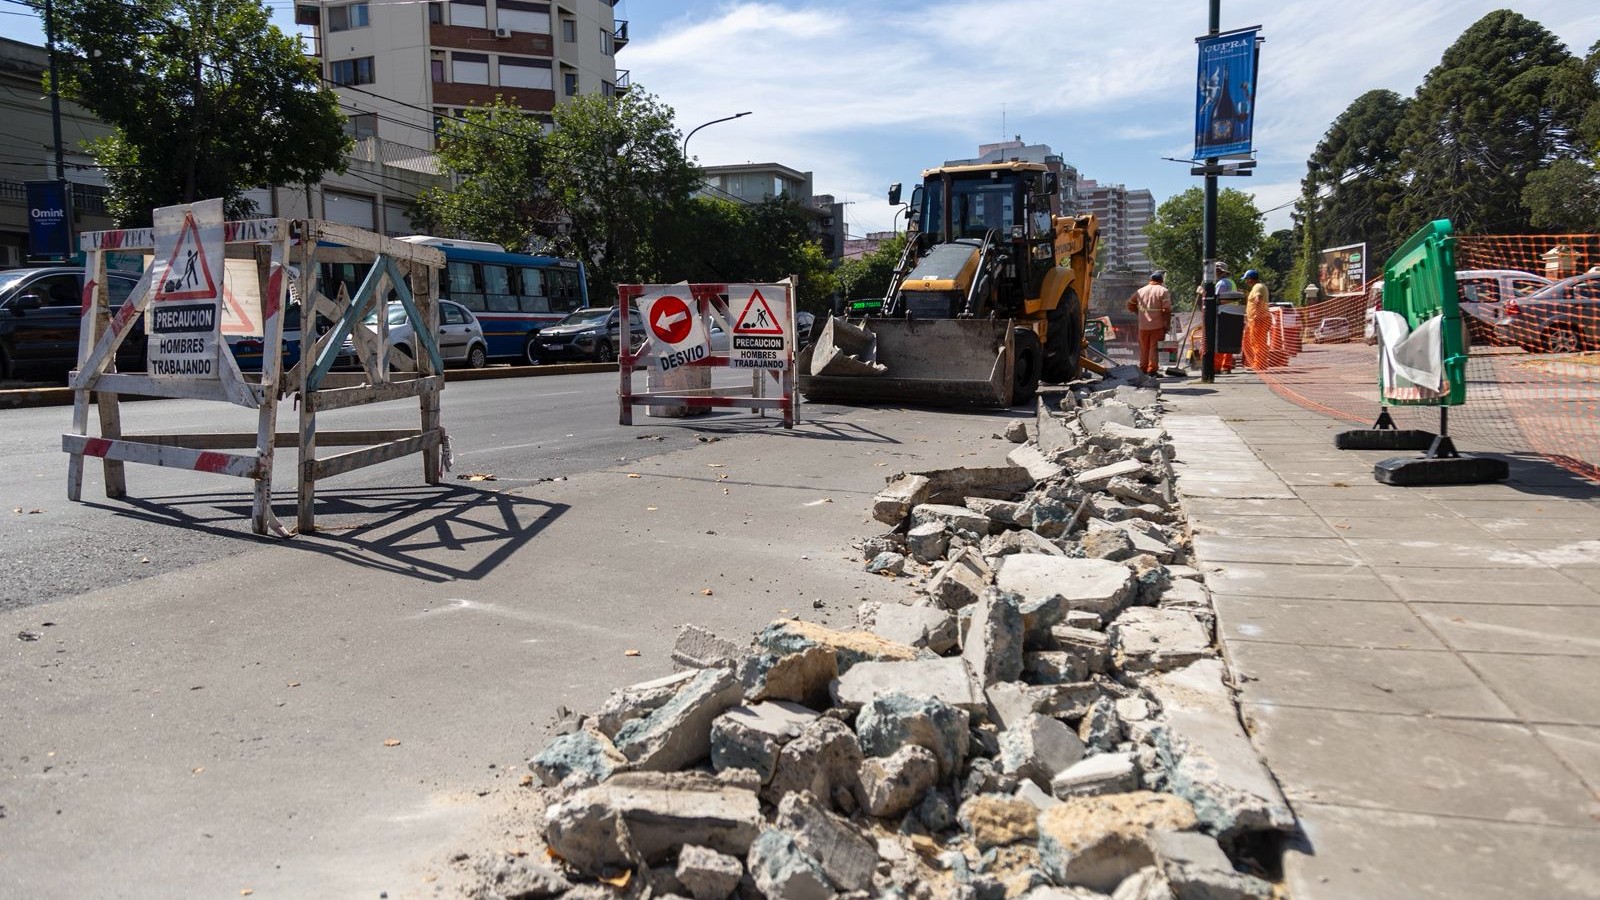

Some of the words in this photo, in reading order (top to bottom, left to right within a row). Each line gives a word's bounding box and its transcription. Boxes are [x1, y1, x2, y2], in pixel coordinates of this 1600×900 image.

[1204, 39, 1249, 53] CUPRA
[31, 208, 64, 218] Omint
[156, 309, 212, 328] PRECAUCION
[160, 338, 205, 354] HOMBRES
[736, 338, 781, 348] PRECAUCION
[660, 345, 704, 371] DESVIO
[740, 351, 777, 359] HOMBRES
[152, 359, 211, 375] TRABAJANDO
[734, 359, 784, 369] TRABAJANDO
